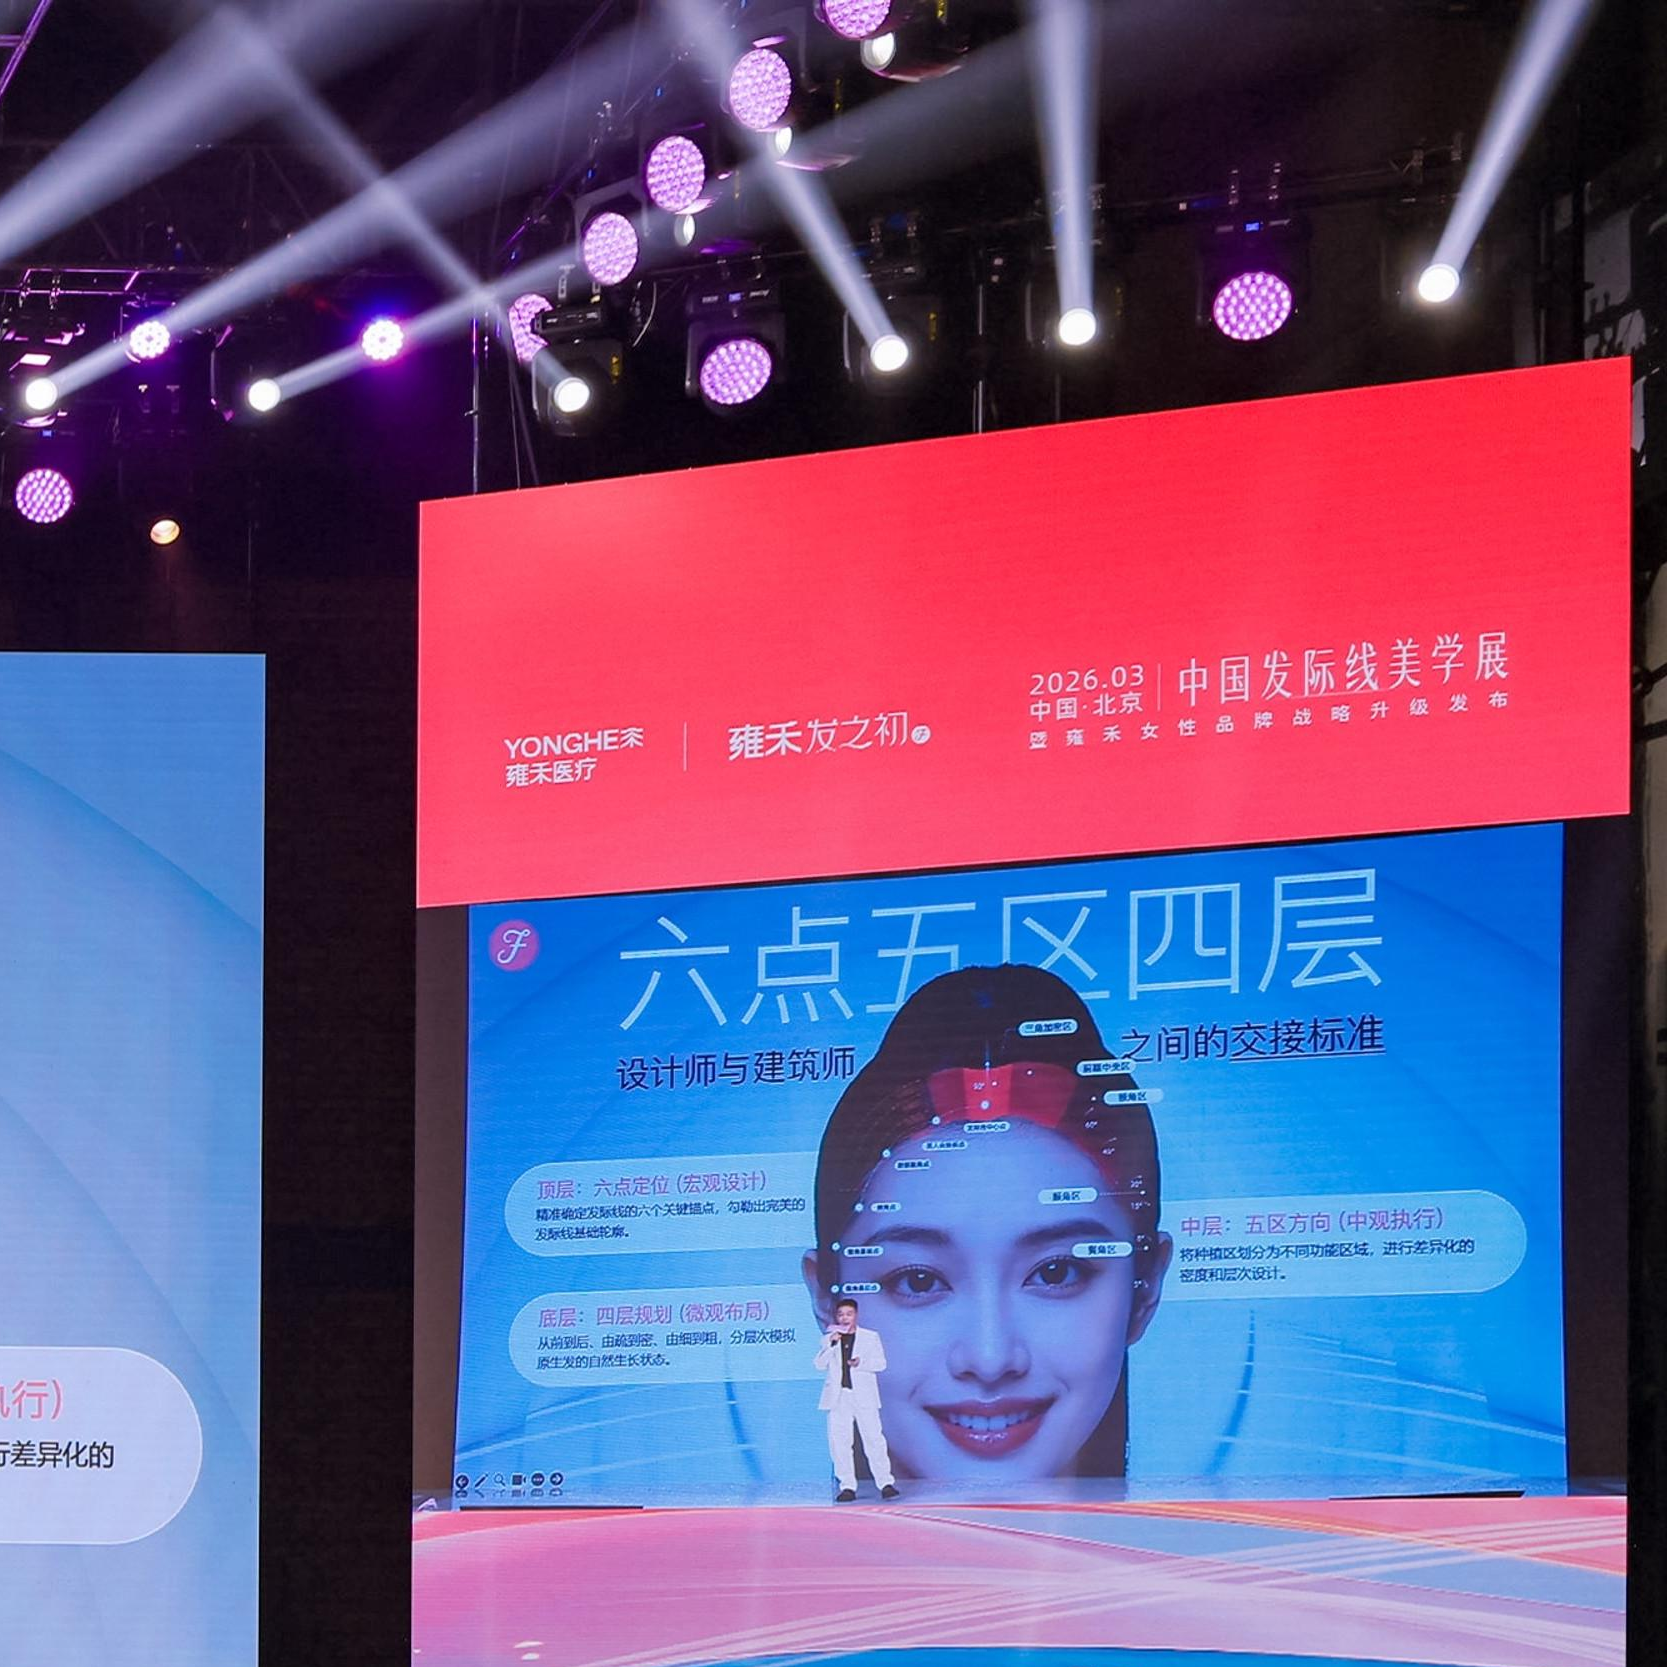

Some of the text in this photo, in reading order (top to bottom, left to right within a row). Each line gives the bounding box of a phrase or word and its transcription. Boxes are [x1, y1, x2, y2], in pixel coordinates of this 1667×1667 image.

[1029, 664, 1145, 697] 2026.03
[1178, 631, 1510, 708] 中国发际线美学展
[1028, 690, 1509, 751] 暨雍禾女性品牌战略升级发布
[1029, 691, 1144, 723] 中国·北京
[504, 728, 619, 760] YONGHE
[728, 711, 908, 761] 雍禾发之初
[505, 757, 598, 788] 雍禾医疗
[619, 867, 1383, 1031] 六点五区四层
[616, 1014, 1385, 1092] 设计师与建筑师 之间的交接标准
